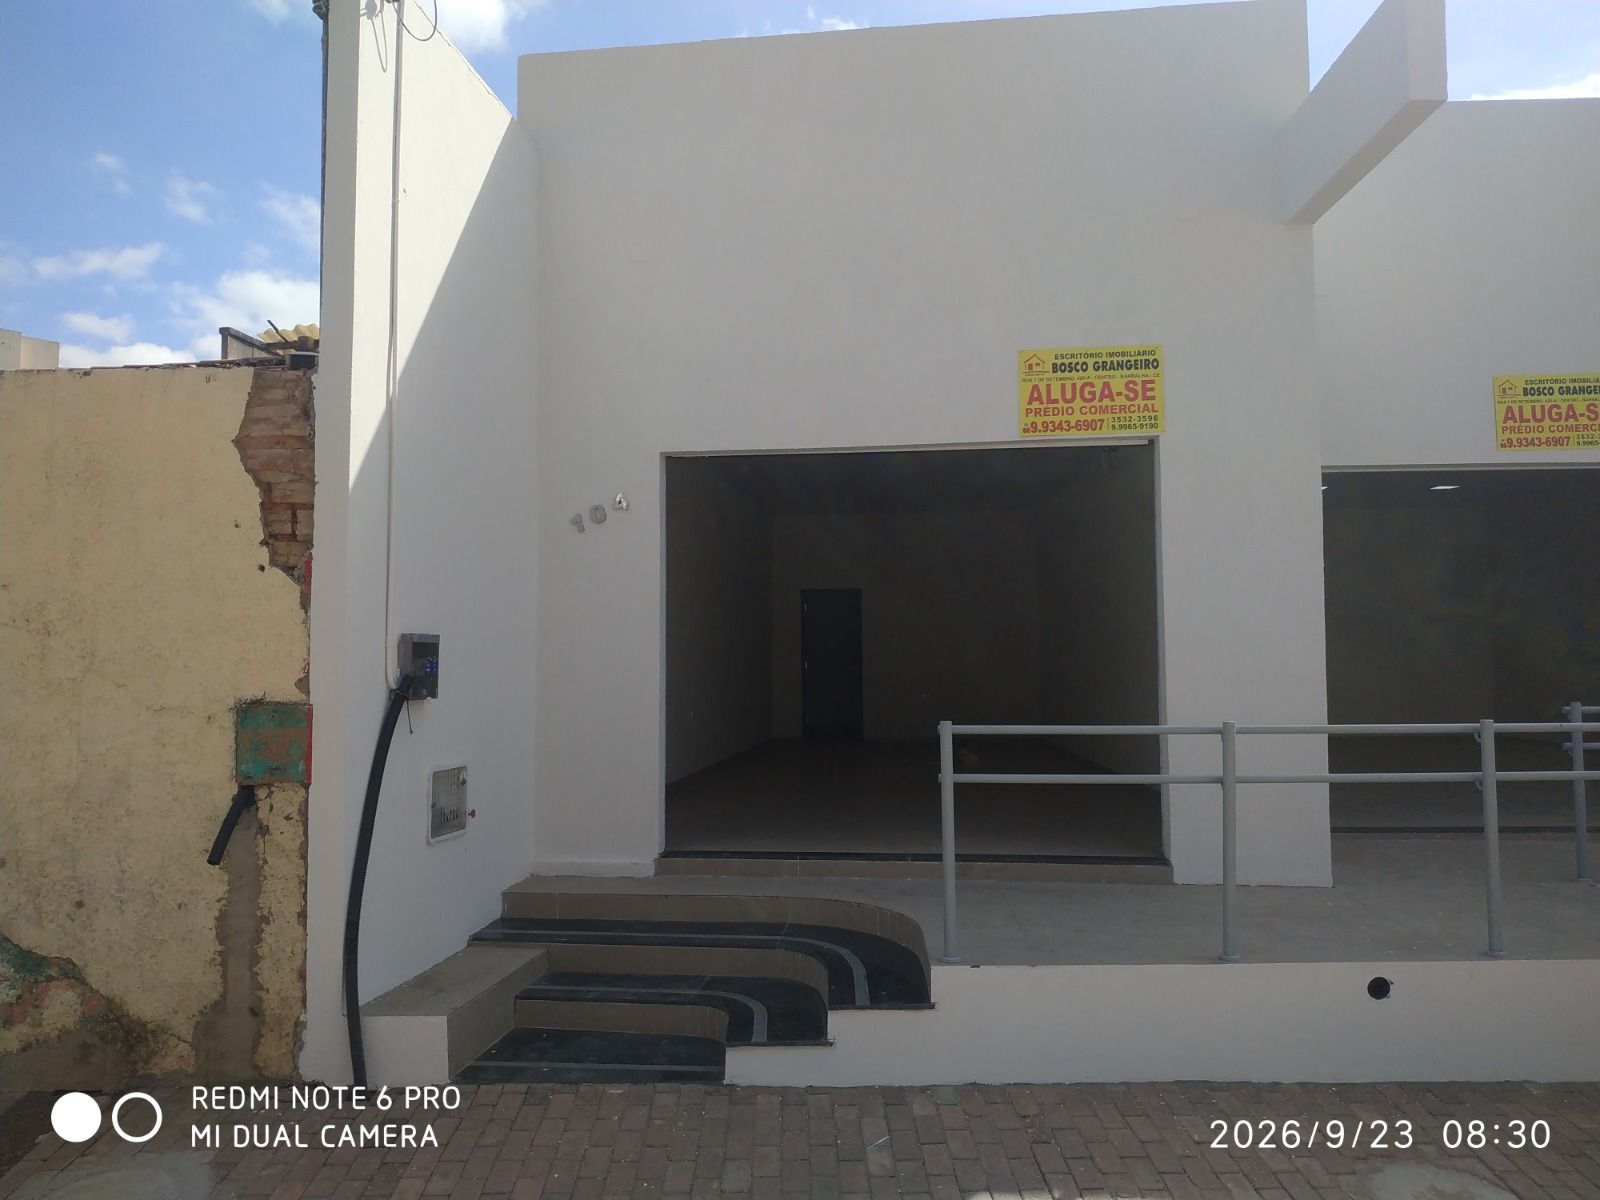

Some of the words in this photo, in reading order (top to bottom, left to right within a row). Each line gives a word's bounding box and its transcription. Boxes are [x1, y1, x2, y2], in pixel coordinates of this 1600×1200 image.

[1054, 351, 1103, 360] ESCRITÓRIO
[1106, 350, 1156, 358] IMOBILIÁRIO
[1052, 361, 1089, 374] BOSCO
[1093, 358, 1160, 372] GRANGEIRO
[1027, 380, 1157, 405] ALUGA-SE
[1522, 386, 1555, 397] BOSCO
[1025, 405, 1075, 417] PRÉDIO
[1079, 403, 1159, 415] COMERCIAL
[1111, 415, 1159, 423] 3532-3596
[1030, 419, 1105, 433] 9.9343-6907
[1111, 422, 1159, 431] 9.9965-9190
[1501, 424, 1545, 435] PRÉDIO
[1506, 436, 1571, 449] 9.9343-6907
[569, 489, 630, 533] 104
